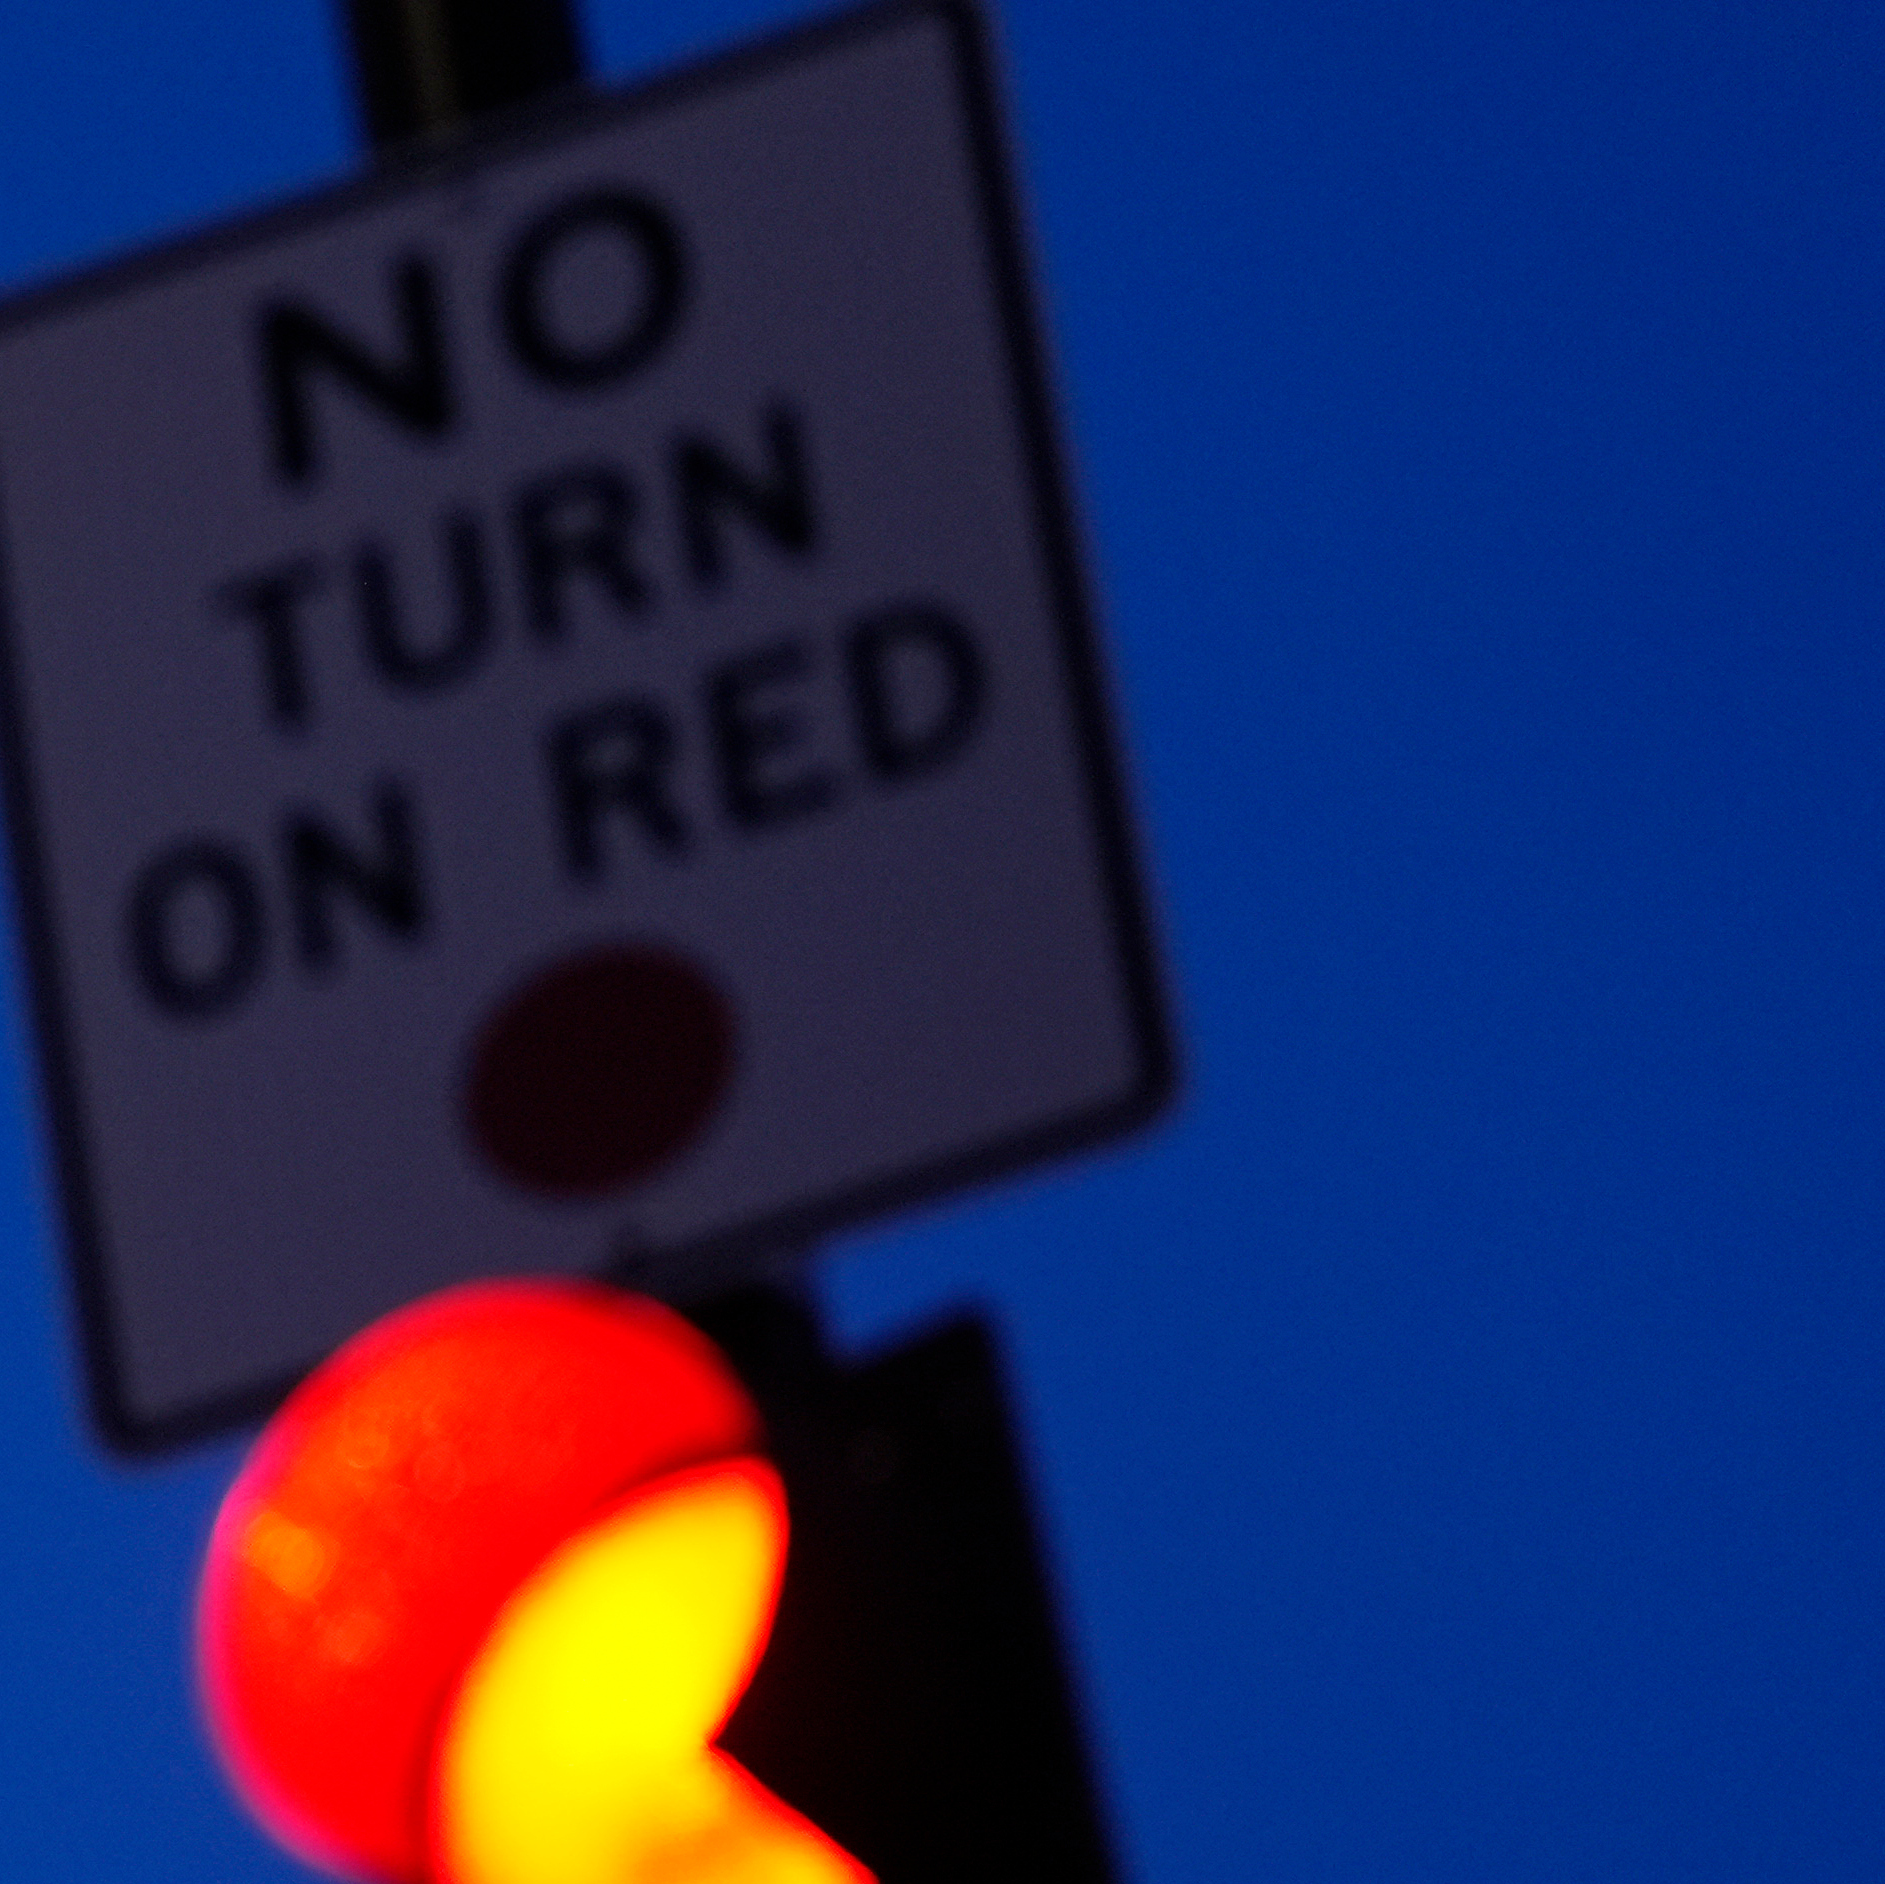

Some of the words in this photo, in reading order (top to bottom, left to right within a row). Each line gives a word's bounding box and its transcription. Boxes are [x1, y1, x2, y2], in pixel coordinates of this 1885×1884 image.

[255, 186, 690, 490] NO
[215, 402, 819, 738] TURN
[123, 772, 429, 1022] ON
[543, 602, 989, 886] RED
